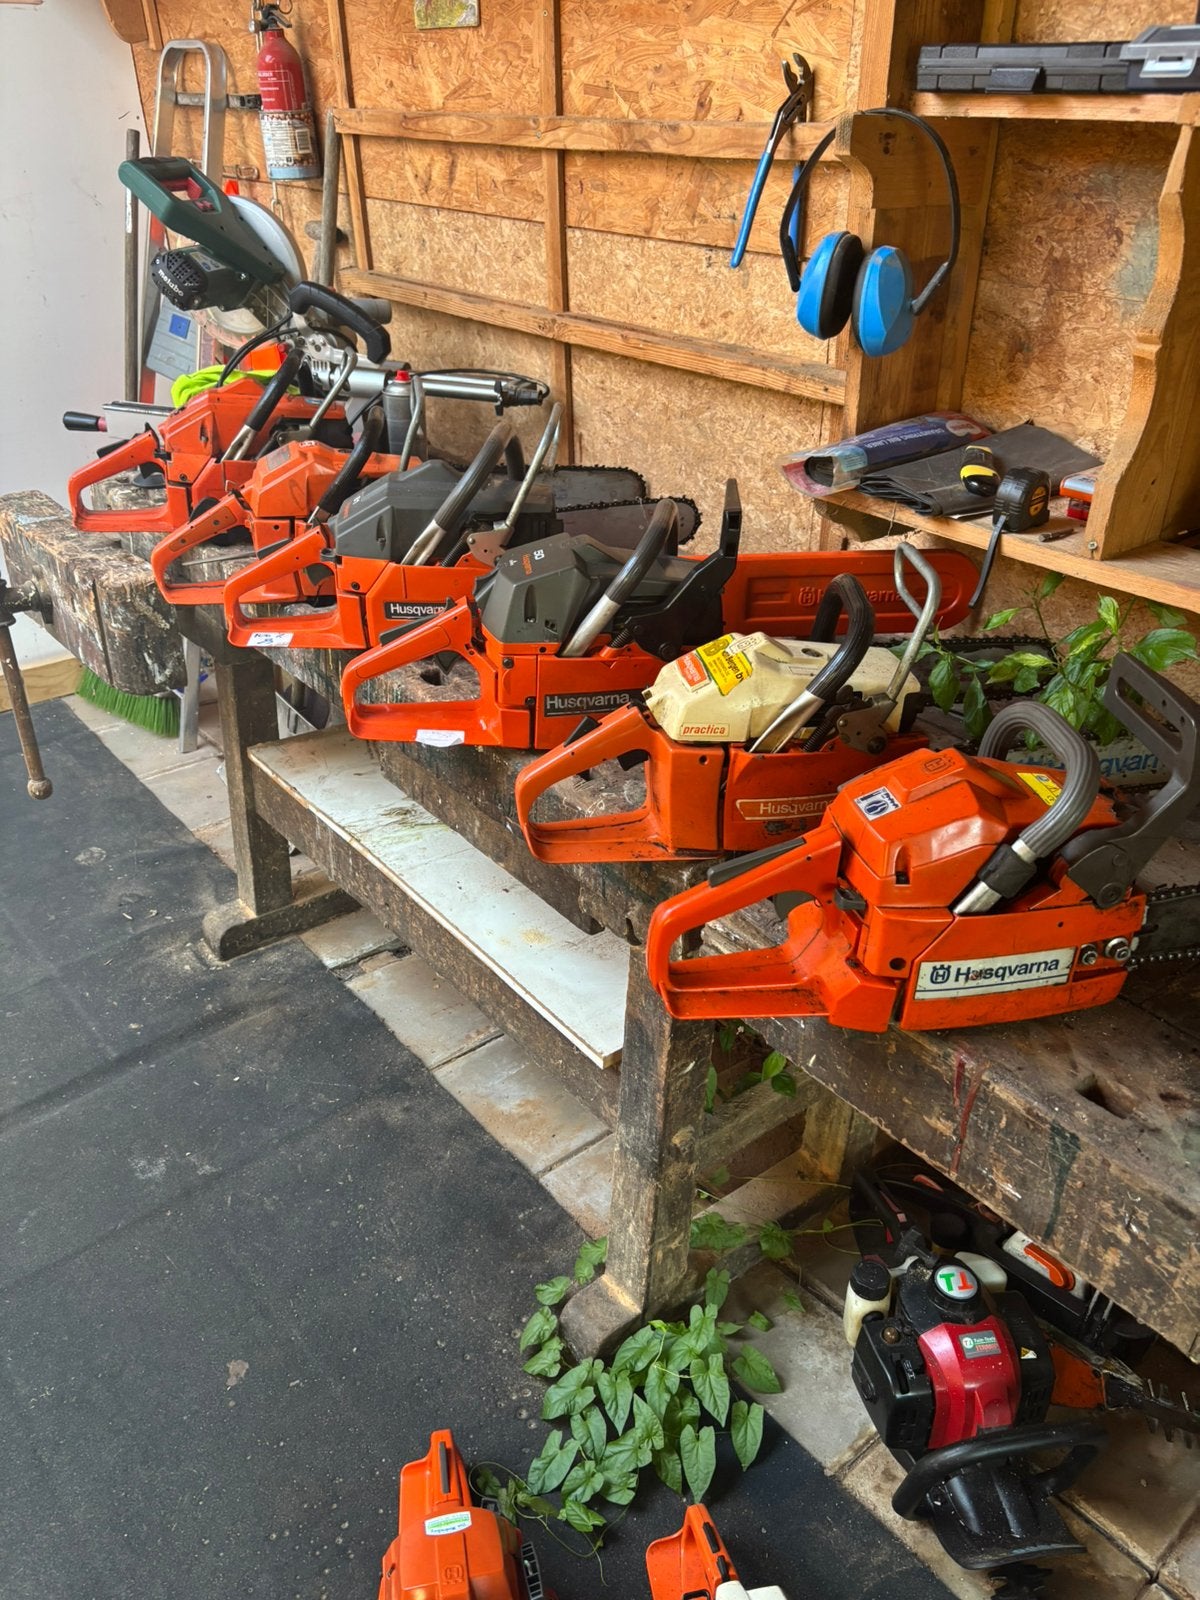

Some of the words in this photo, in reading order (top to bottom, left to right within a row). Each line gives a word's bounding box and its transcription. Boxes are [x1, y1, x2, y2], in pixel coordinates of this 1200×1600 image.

[158, 268, 184, 297] metabo
[533, 549, 545, 561] 50
[546, 692, 630, 709] Husqvarna
[682, 725, 726, 735] practica
[954, 959, 1060, 982] Husqvarna
